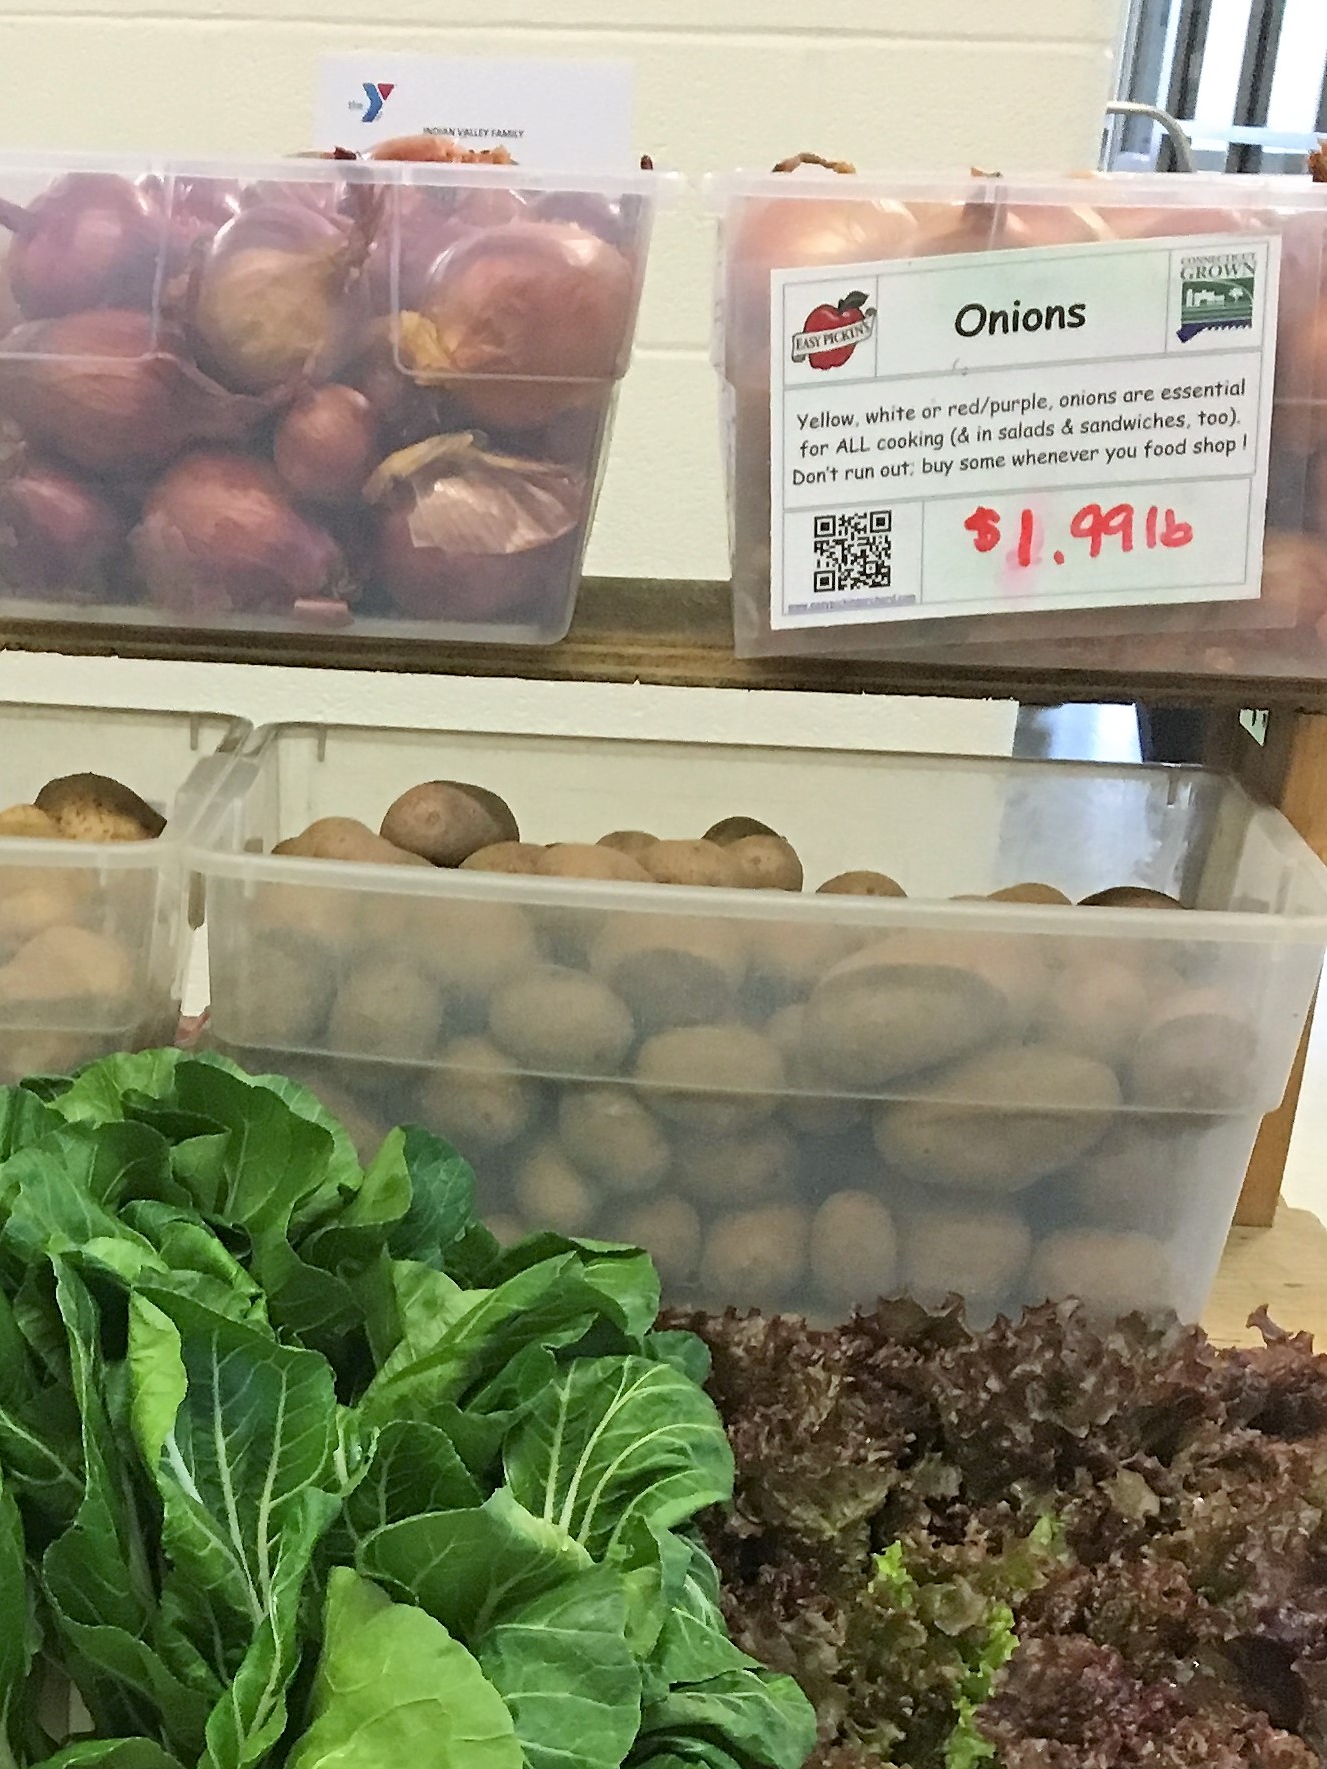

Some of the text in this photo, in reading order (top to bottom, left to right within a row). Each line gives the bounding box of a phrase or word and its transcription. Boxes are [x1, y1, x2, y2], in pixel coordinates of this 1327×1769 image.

[1180, 261, 1255, 280] GROWN
[955, 300, 1086, 337] Onions
[796, 334, 821, 350] EASY
[797, 378, 1245, 430] Yellow, white or red/purple, onions are essential
[800, 441, 828, 458] for
[836, 436, 870, 454] ALL
[877, 432, 943, 450] cooking
[950, 427, 969, 447] (&
[977, 426, 991, 441] in
[998, 420, 1055, 441] salads
[1080, 412, 1191, 434] sandwiches,
[793, 467, 838, 486] Don't
[845, 465, 874, 480] run
[922, 457, 953, 476] buy
[960, 455, 1005, 471] some
[1012, 449, 1099, 467] whenever
[1105, 445, 1137, 464] you
[1144, 439, 1186, 458] food
[1193, 437, 1236, 457] shop
